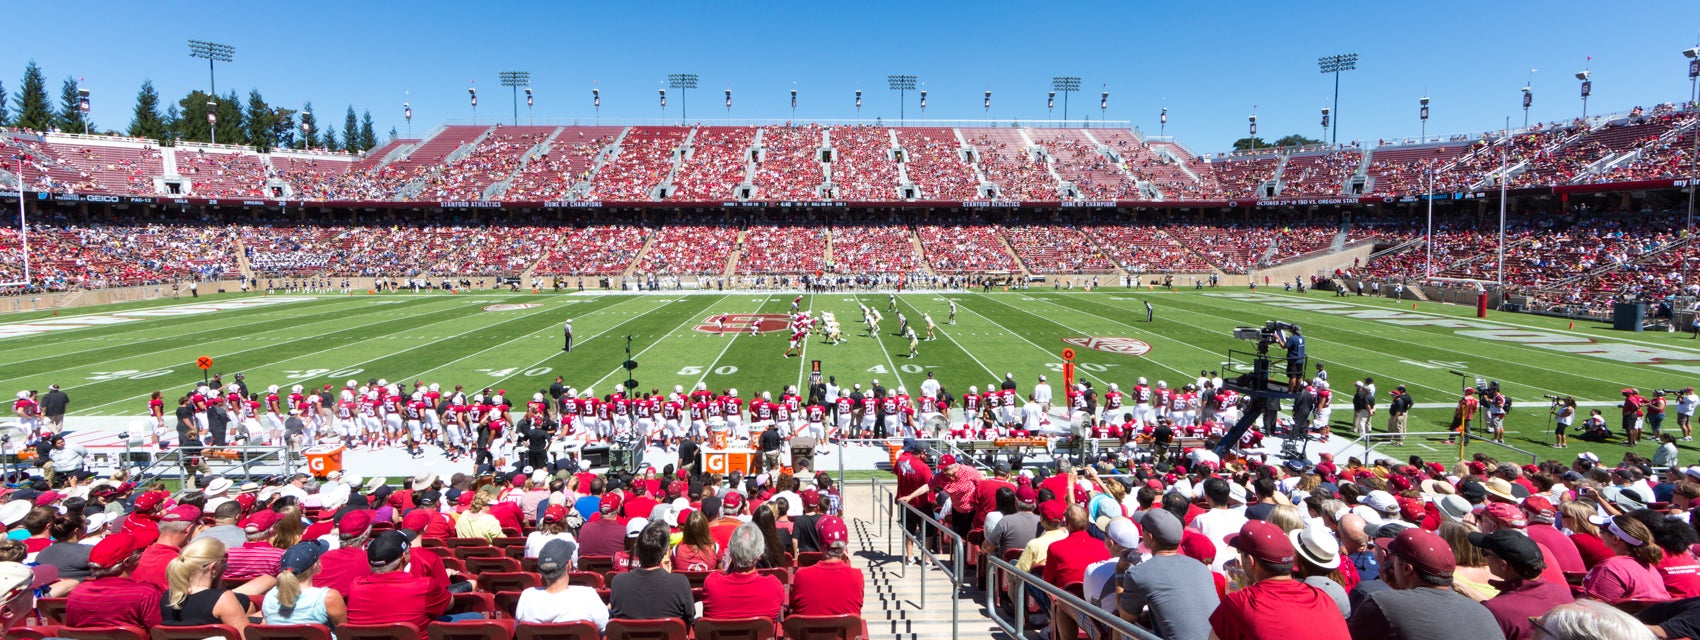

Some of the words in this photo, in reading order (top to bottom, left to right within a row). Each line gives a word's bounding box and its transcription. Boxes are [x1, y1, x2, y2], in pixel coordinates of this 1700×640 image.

[1674, 179, 1687, 187] my
[87, 194, 119, 203] GEICO
[677, 366, 738, 375] 50
[867, 364, 924, 374] 40
[1174, 400, 1186, 410] 66
[311, 457, 325, 471] G
[709, 455, 723, 470] G
